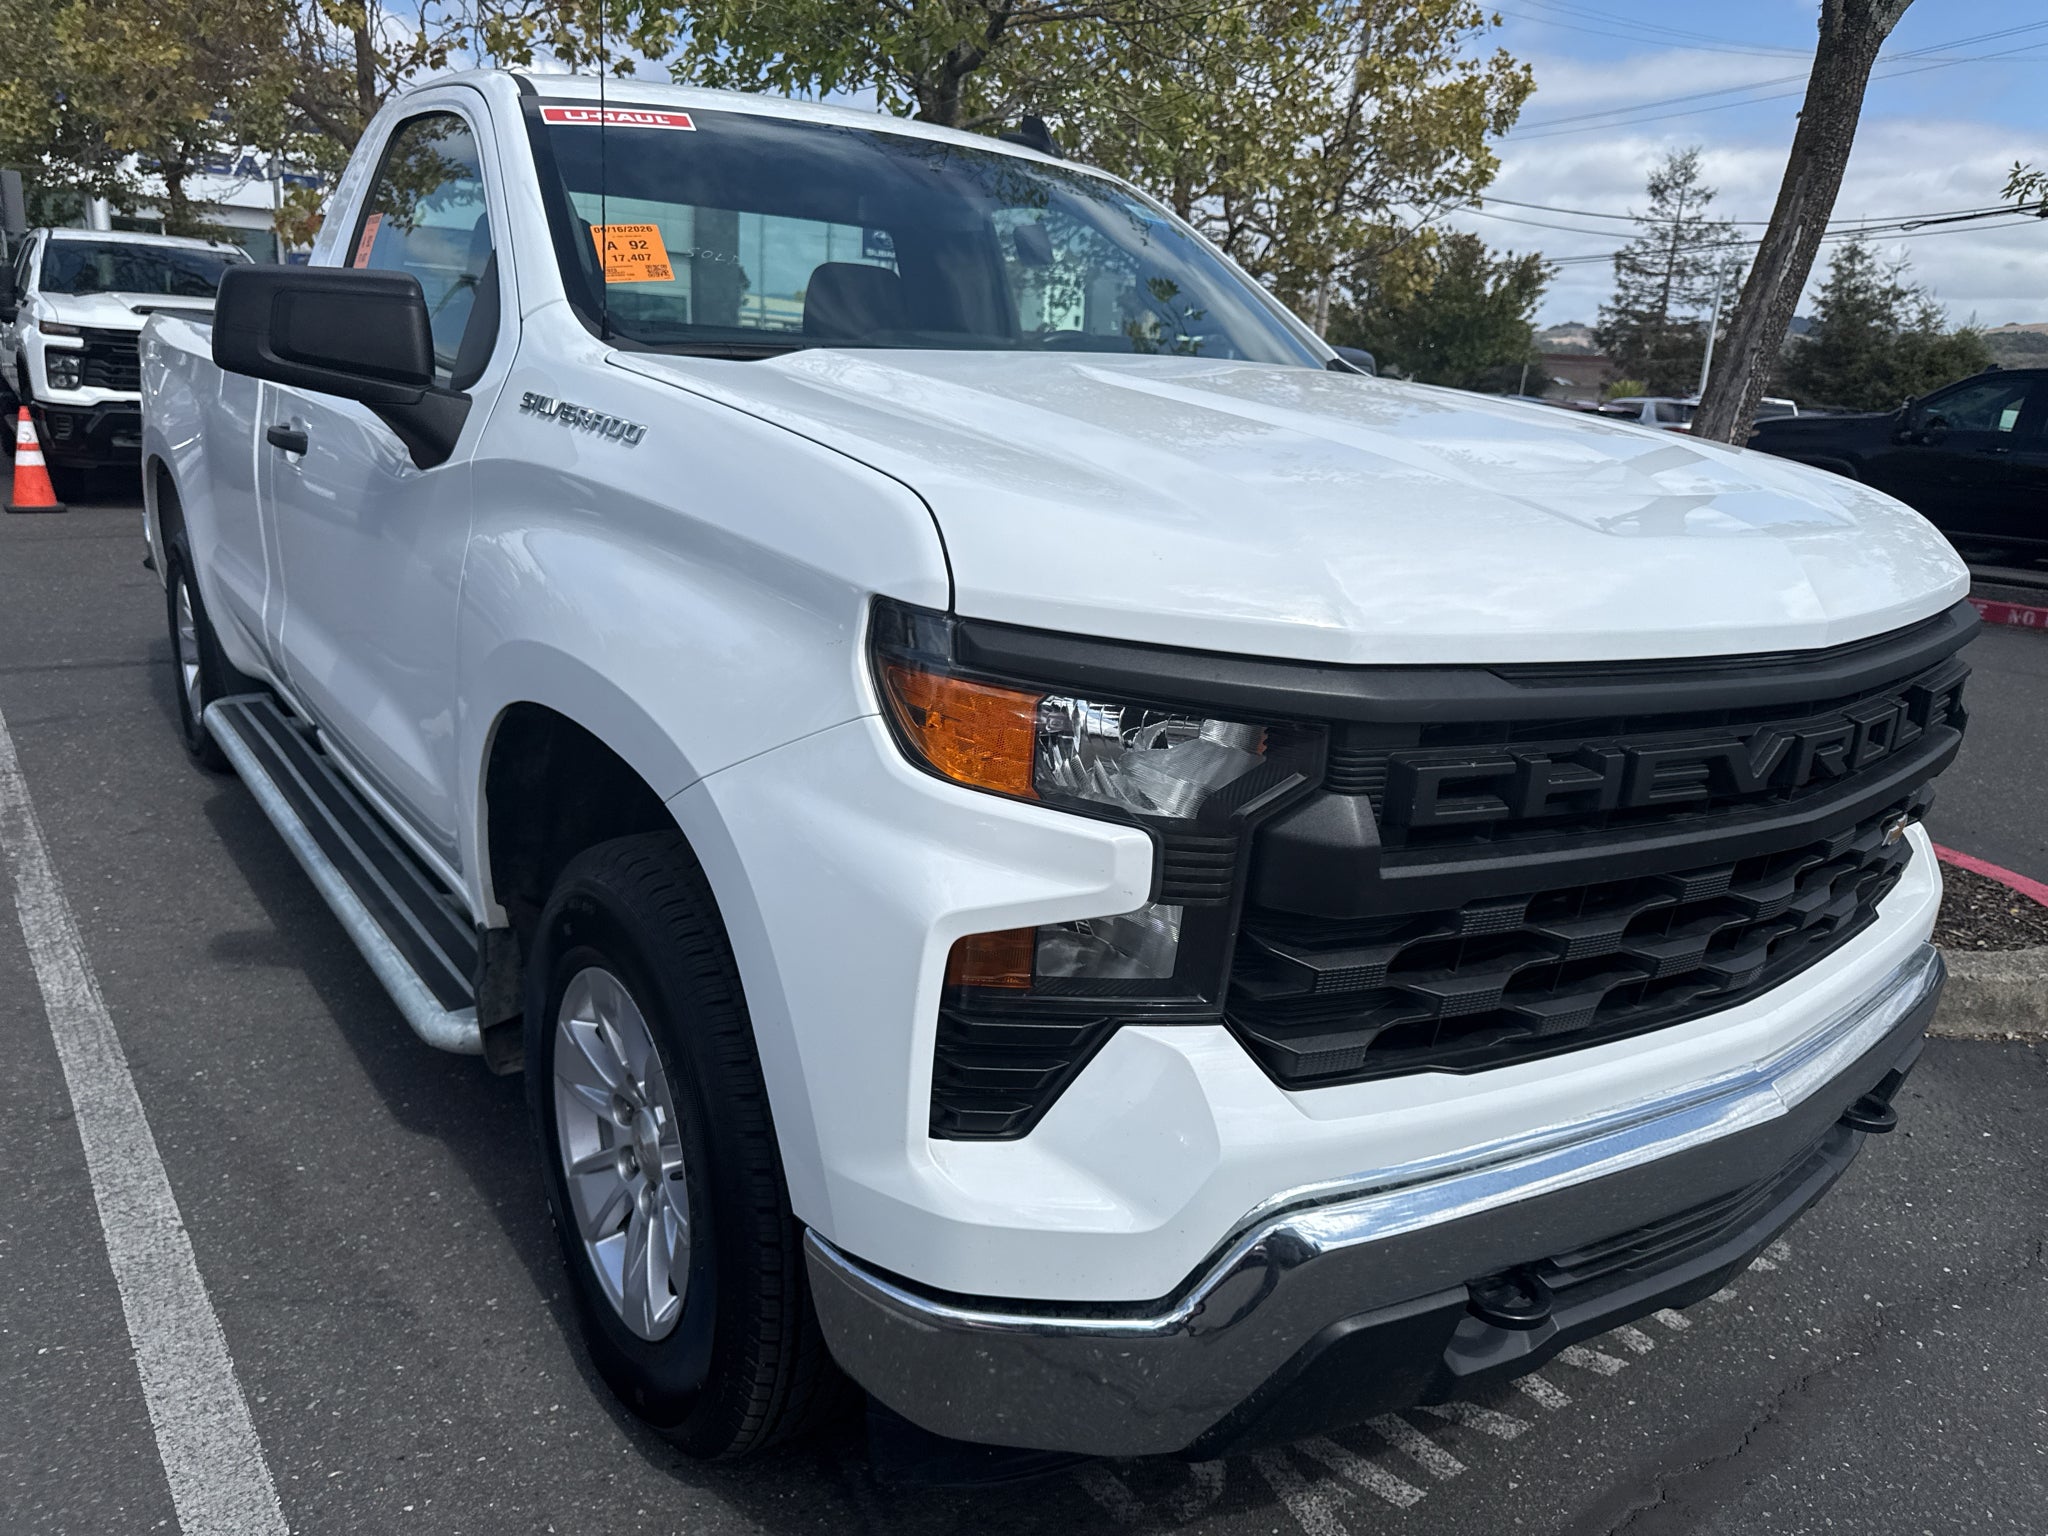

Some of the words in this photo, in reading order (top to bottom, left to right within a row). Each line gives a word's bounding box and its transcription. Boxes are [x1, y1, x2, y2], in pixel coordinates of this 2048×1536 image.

[563, 111, 671, 125] U-HAUL
[607, 241, 618, 251] A
[629, 240, 649, 250] 92
[520, 391, 648, 446] SILVERADO
